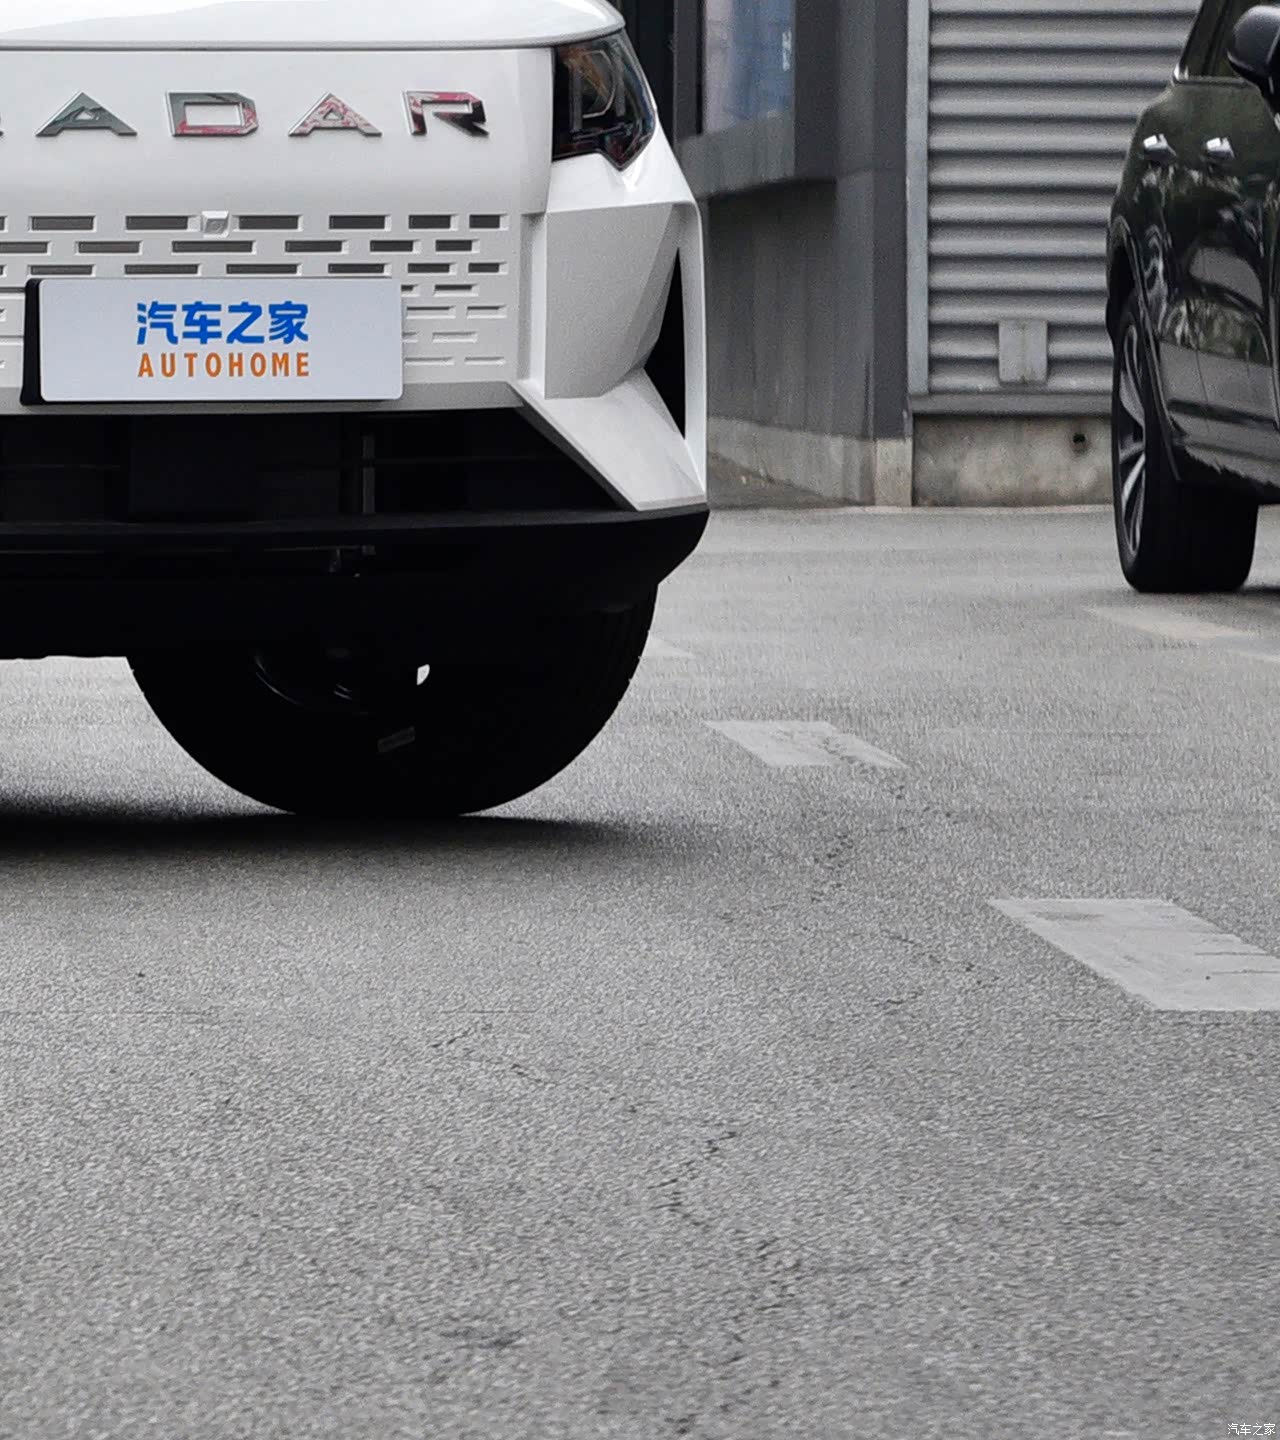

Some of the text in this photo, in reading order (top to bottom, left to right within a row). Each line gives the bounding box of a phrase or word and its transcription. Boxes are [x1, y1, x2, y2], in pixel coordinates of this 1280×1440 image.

[136, 301, 309, 346] 汽车之家
[137, 352, 310, 378] AUTOHOME
